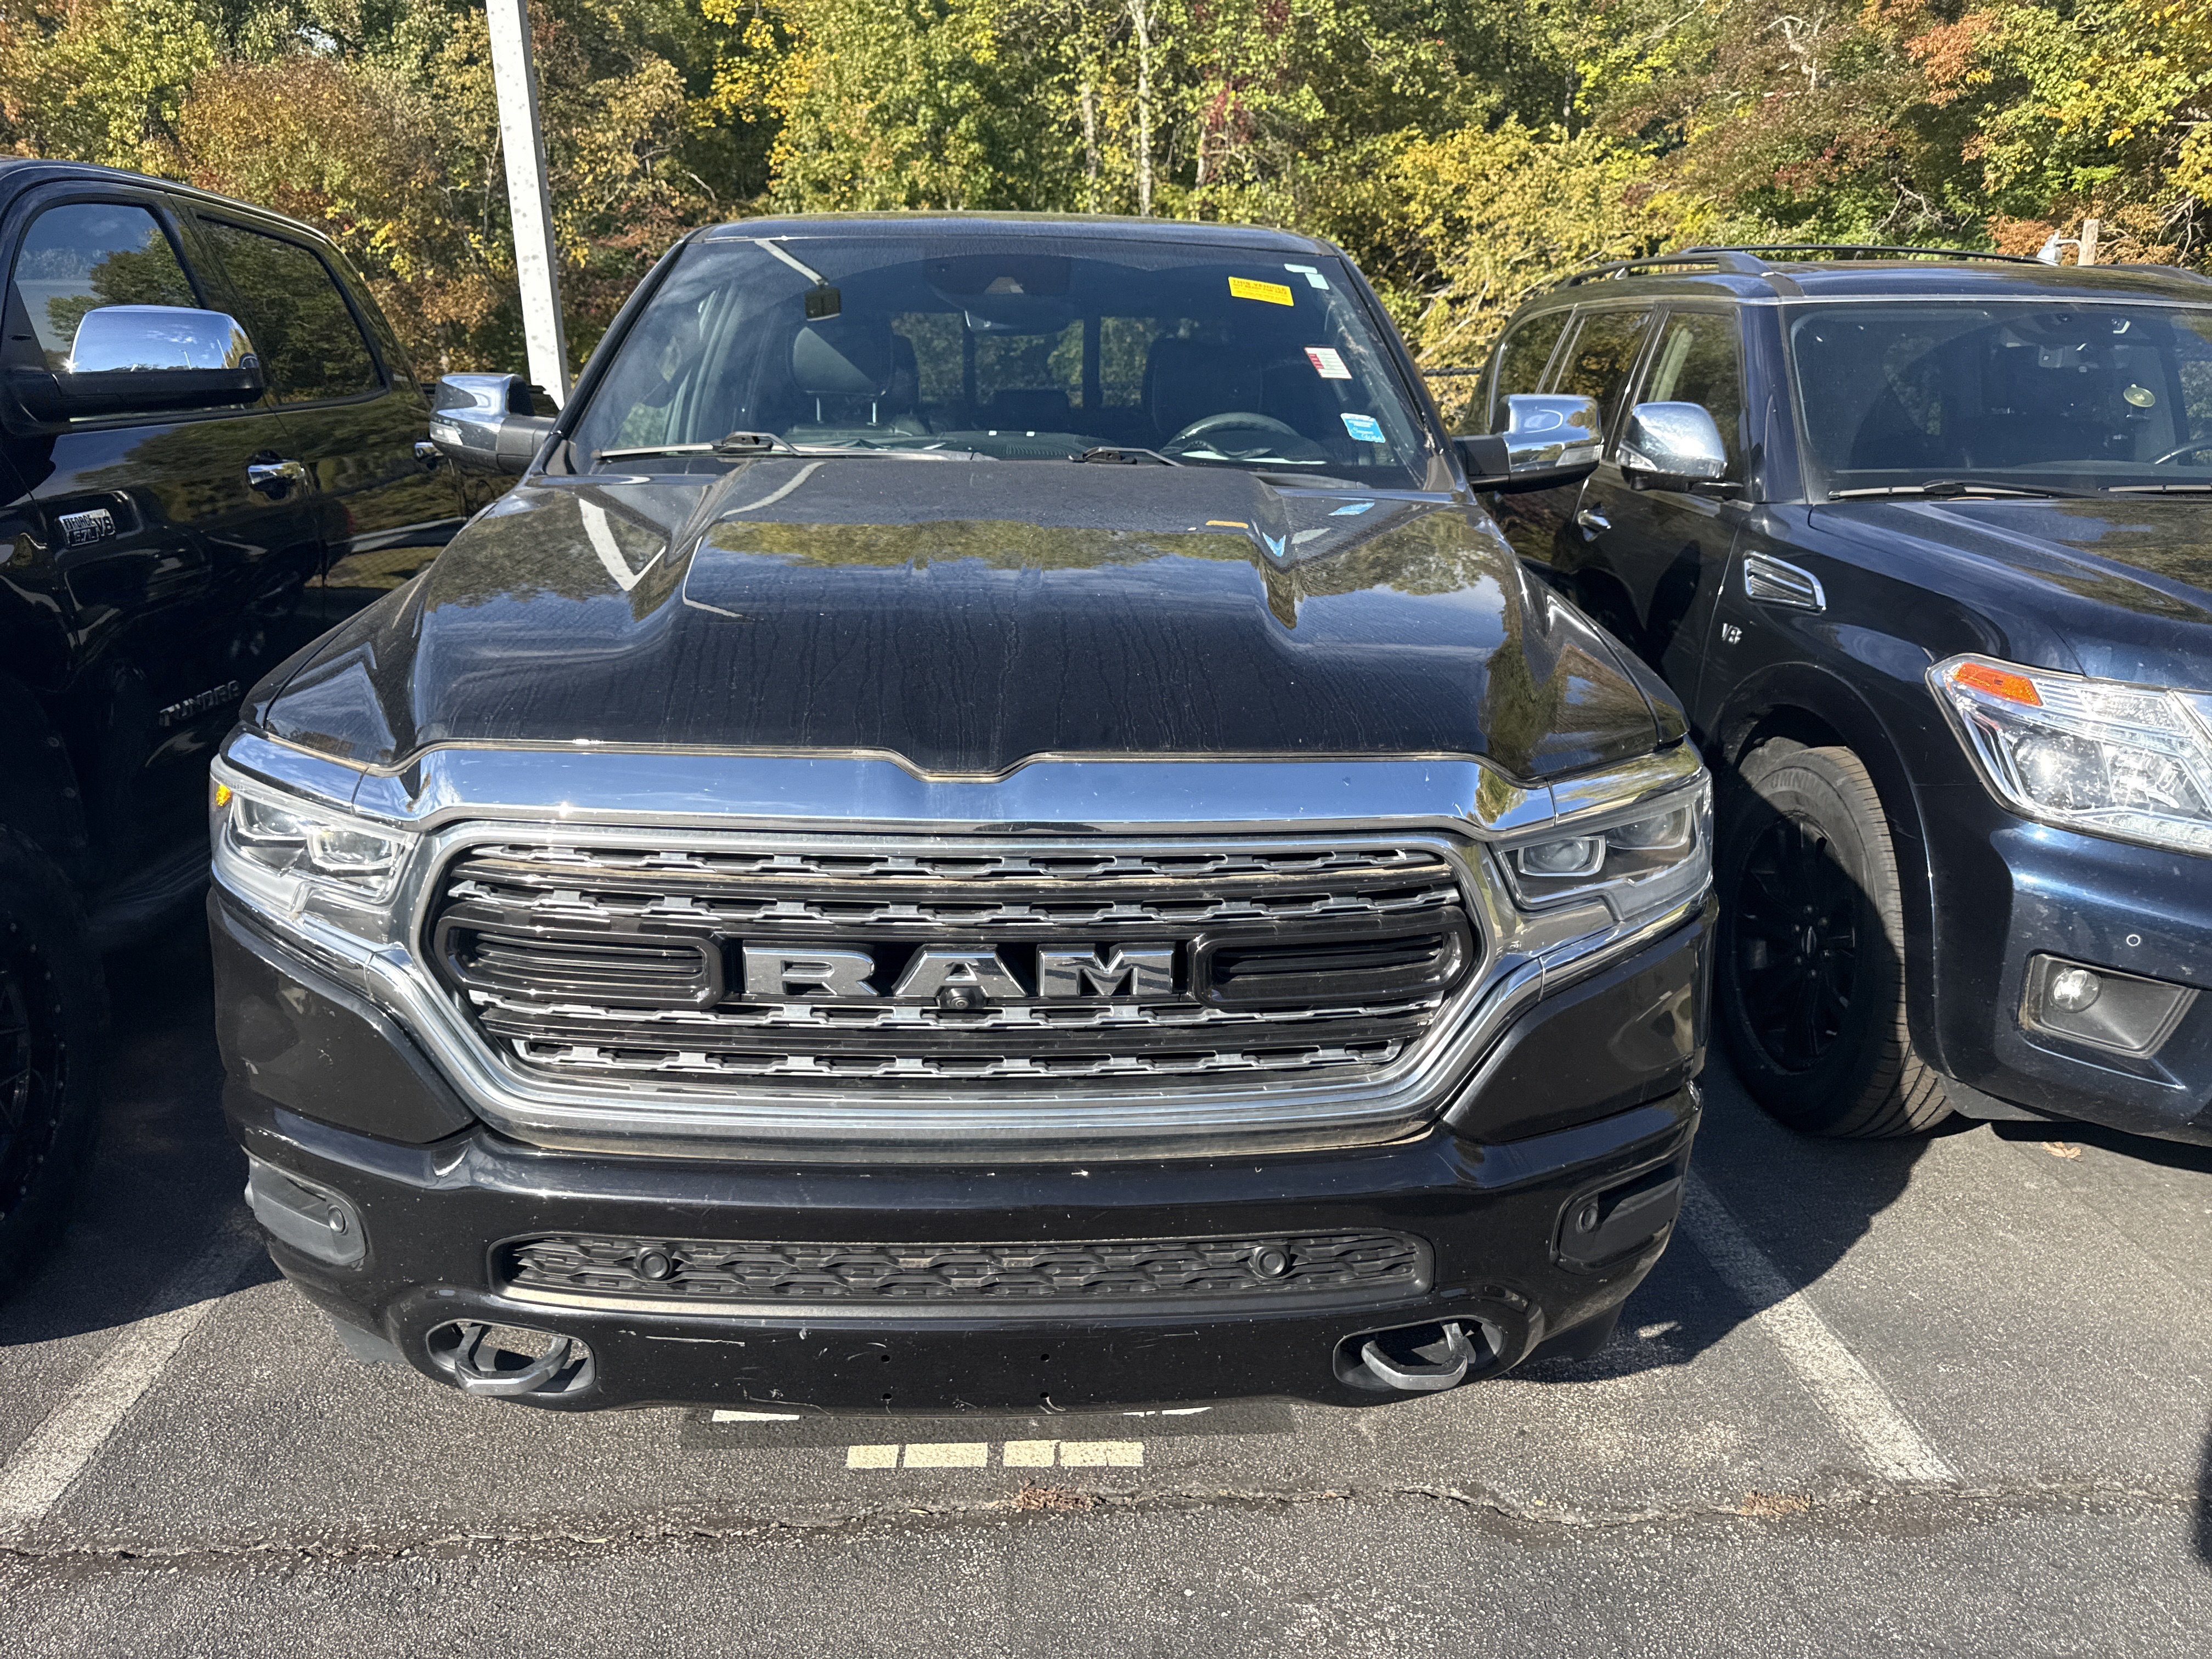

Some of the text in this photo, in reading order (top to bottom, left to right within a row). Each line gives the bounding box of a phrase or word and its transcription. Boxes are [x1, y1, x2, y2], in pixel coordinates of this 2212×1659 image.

[94, 516, 115, 537] V8
[1722, 623, 1742, 645] V8
[159, 680, 241, 726] TUNDRA
[742, 941, 1175, 997] RAM
